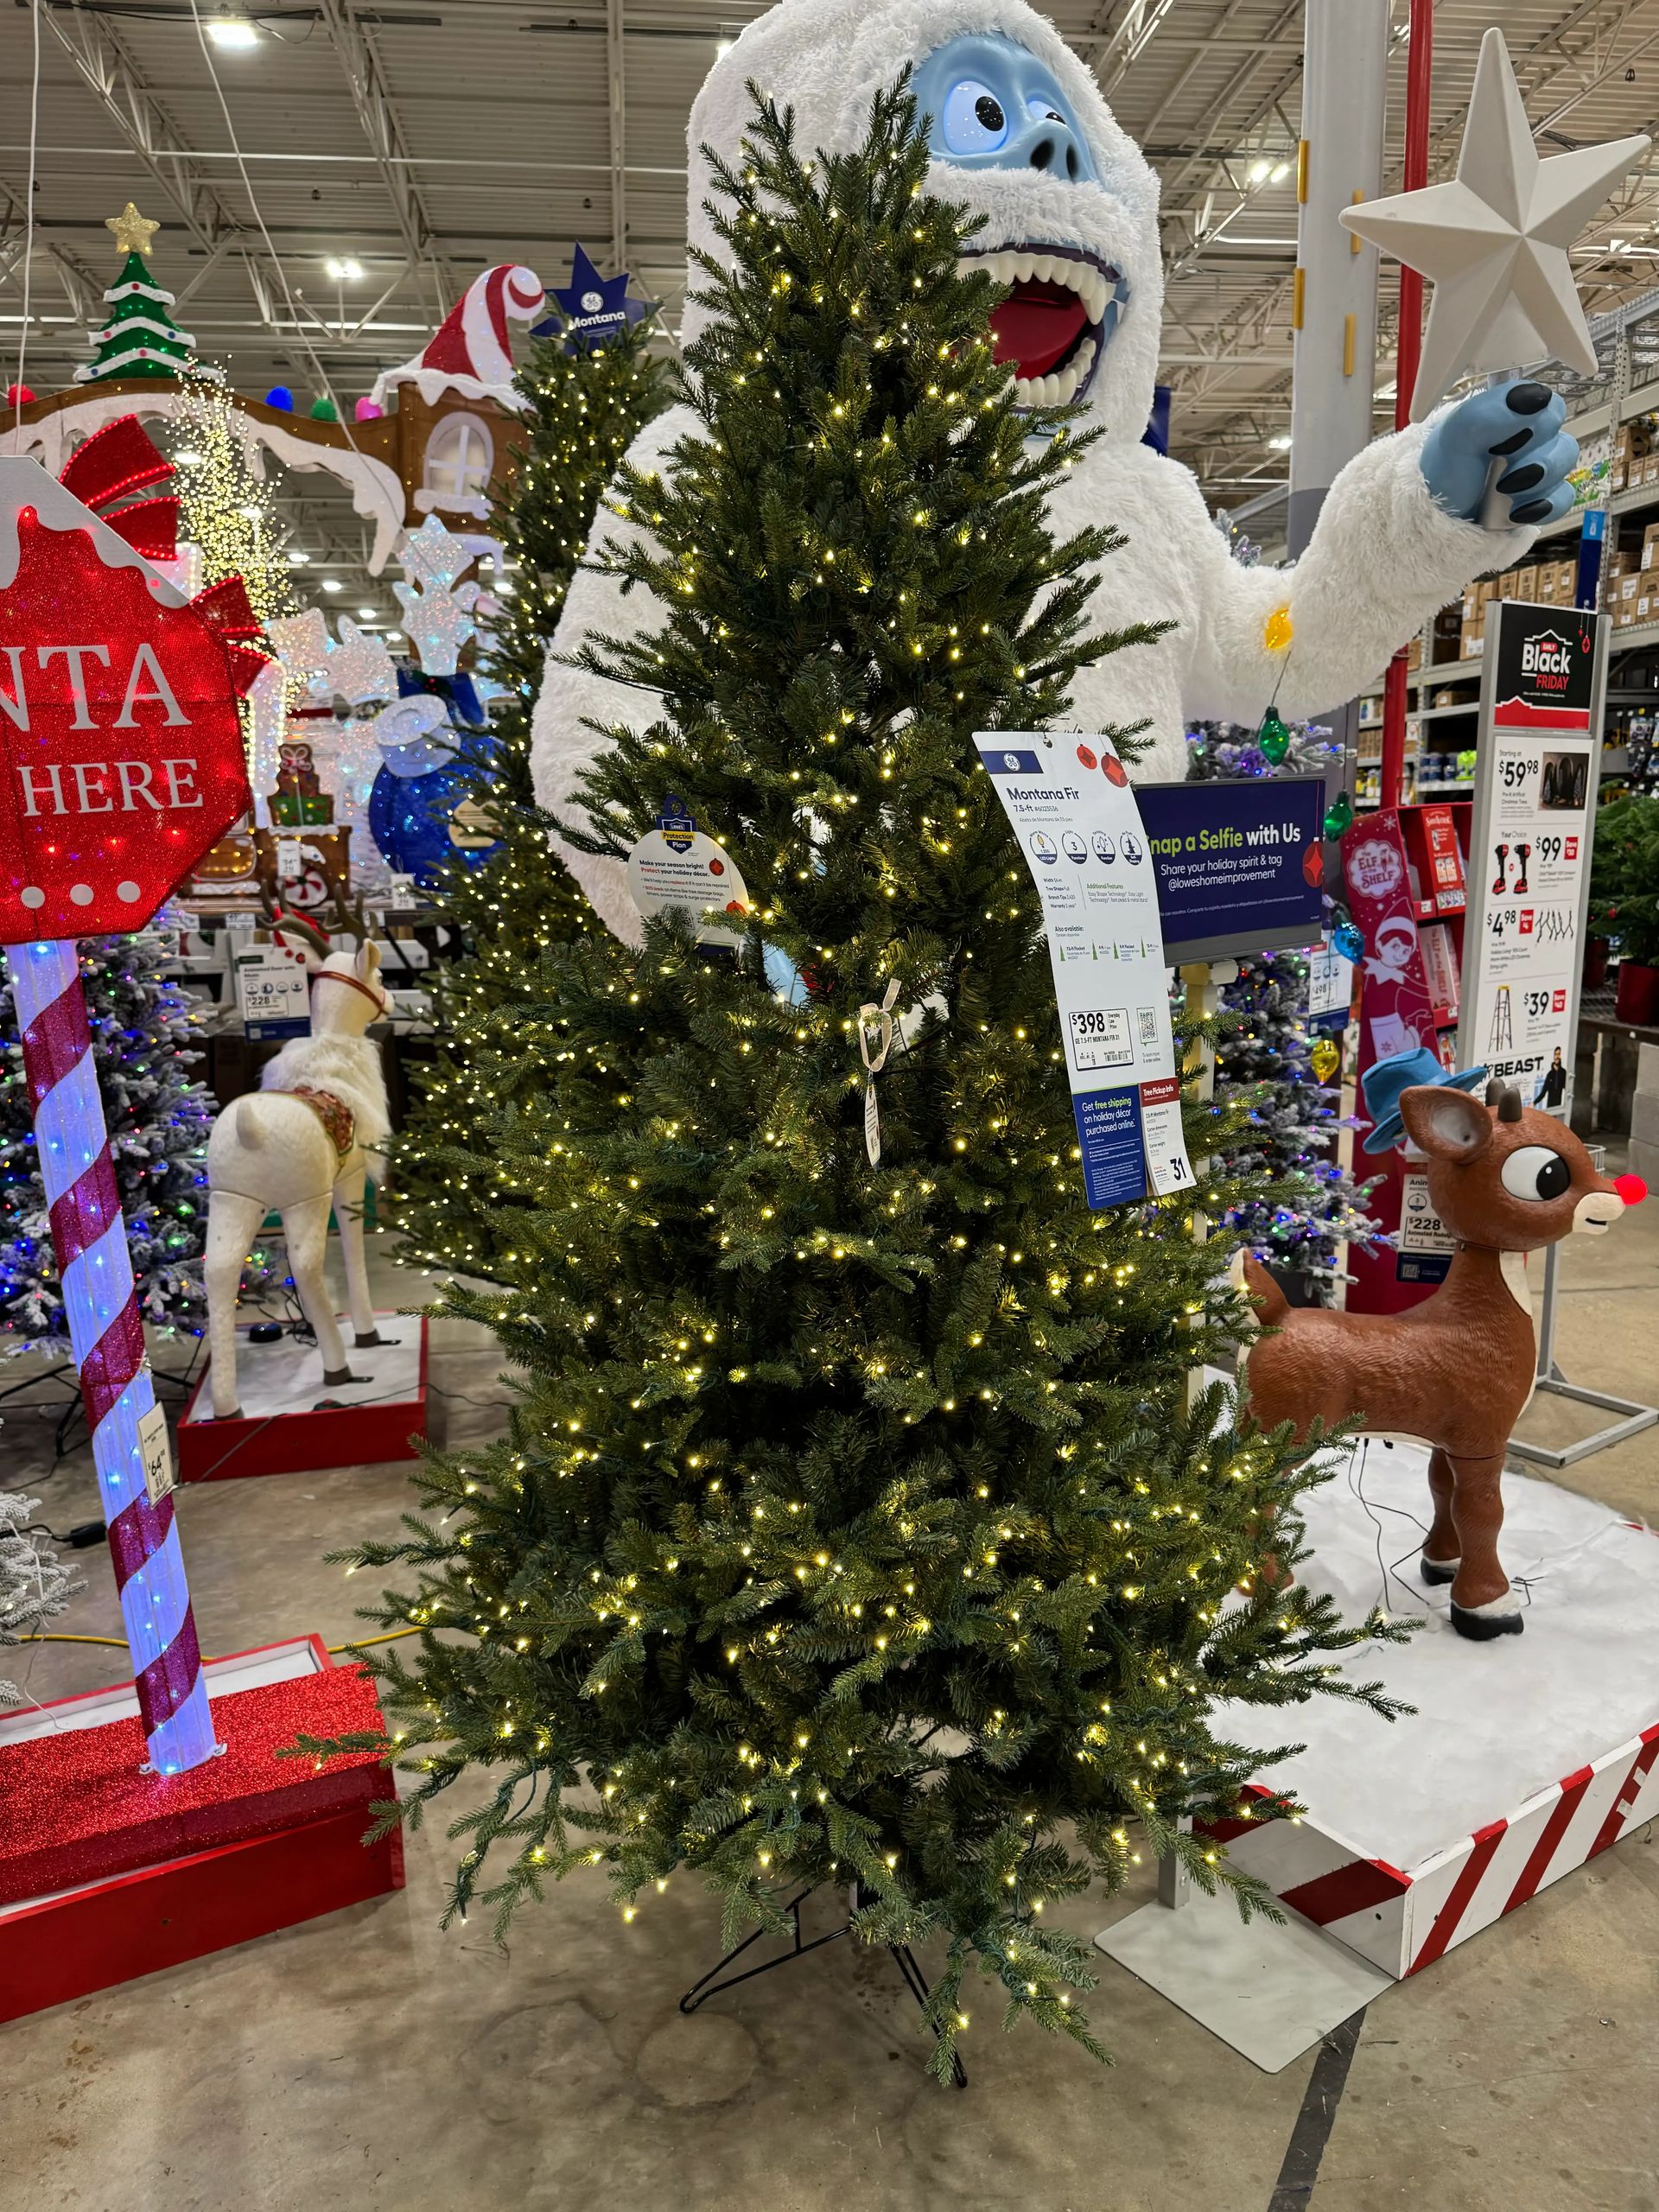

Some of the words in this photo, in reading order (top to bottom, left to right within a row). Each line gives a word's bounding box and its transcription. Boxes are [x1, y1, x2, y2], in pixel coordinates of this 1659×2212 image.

[569, 311, 626, 328] Montana
[1522, 643, 1572, 674] Black
[1536, 675, 1569, 690] FRIDAY
[1499, 749, 1516, 758] Starting
[16, 759, 204, 817] HERE
[1007, 787, 1065, 800] Montana
[1065, 787, 1079, 800] Fir
[1071, 842, 1077, 851] 3
[1146, 835, 1182, 857] nap
[1185, 836, 1196, 852] a
[1198, 827, 1243, 850] Selfie
[1246, 824, 1279, 846] with
[1282, 823, 1301, 843] Us
[1535, 836, 1561, 861] $99
[1160, 863, 1185, 876] Share
[1187, 862, 1206, 876] your
[1207, 858, 1238, 872] holiday
[1238, 855, 1259, 868] spirit
[1260, 854, 1267, 865] &
[1268, 855, 1282, 867] tag
[1357, 856, 1377, 871] ELF
[1168, 868, 1275, 892] @loweshomeimprovement
[1362, 870, 1395, 889] SHELF
[1523, 991, 1549, 1016] $39
[1071, 1012, 1105, 1034] $398
[1143, 1088, 1153, 1096] Tree
[1153, 1086, 1166, 1096] Pickup
[1166, 1084, 1174, 1093] Info
[1082, 1102, 1095, 1112] Get
[1094, 1100, 1108, 1110] free
[1108, 1096, 1132, 1109] shipping
[1093, 1110, 1116, 1122] holiday
[1116, 1109, 1131, 1118] décor
[1085, 1123, 1117, 1138] purchased
[1170, 1157, 1186, 1181] 31
[1408, 1218, 1440, 1230] $228
